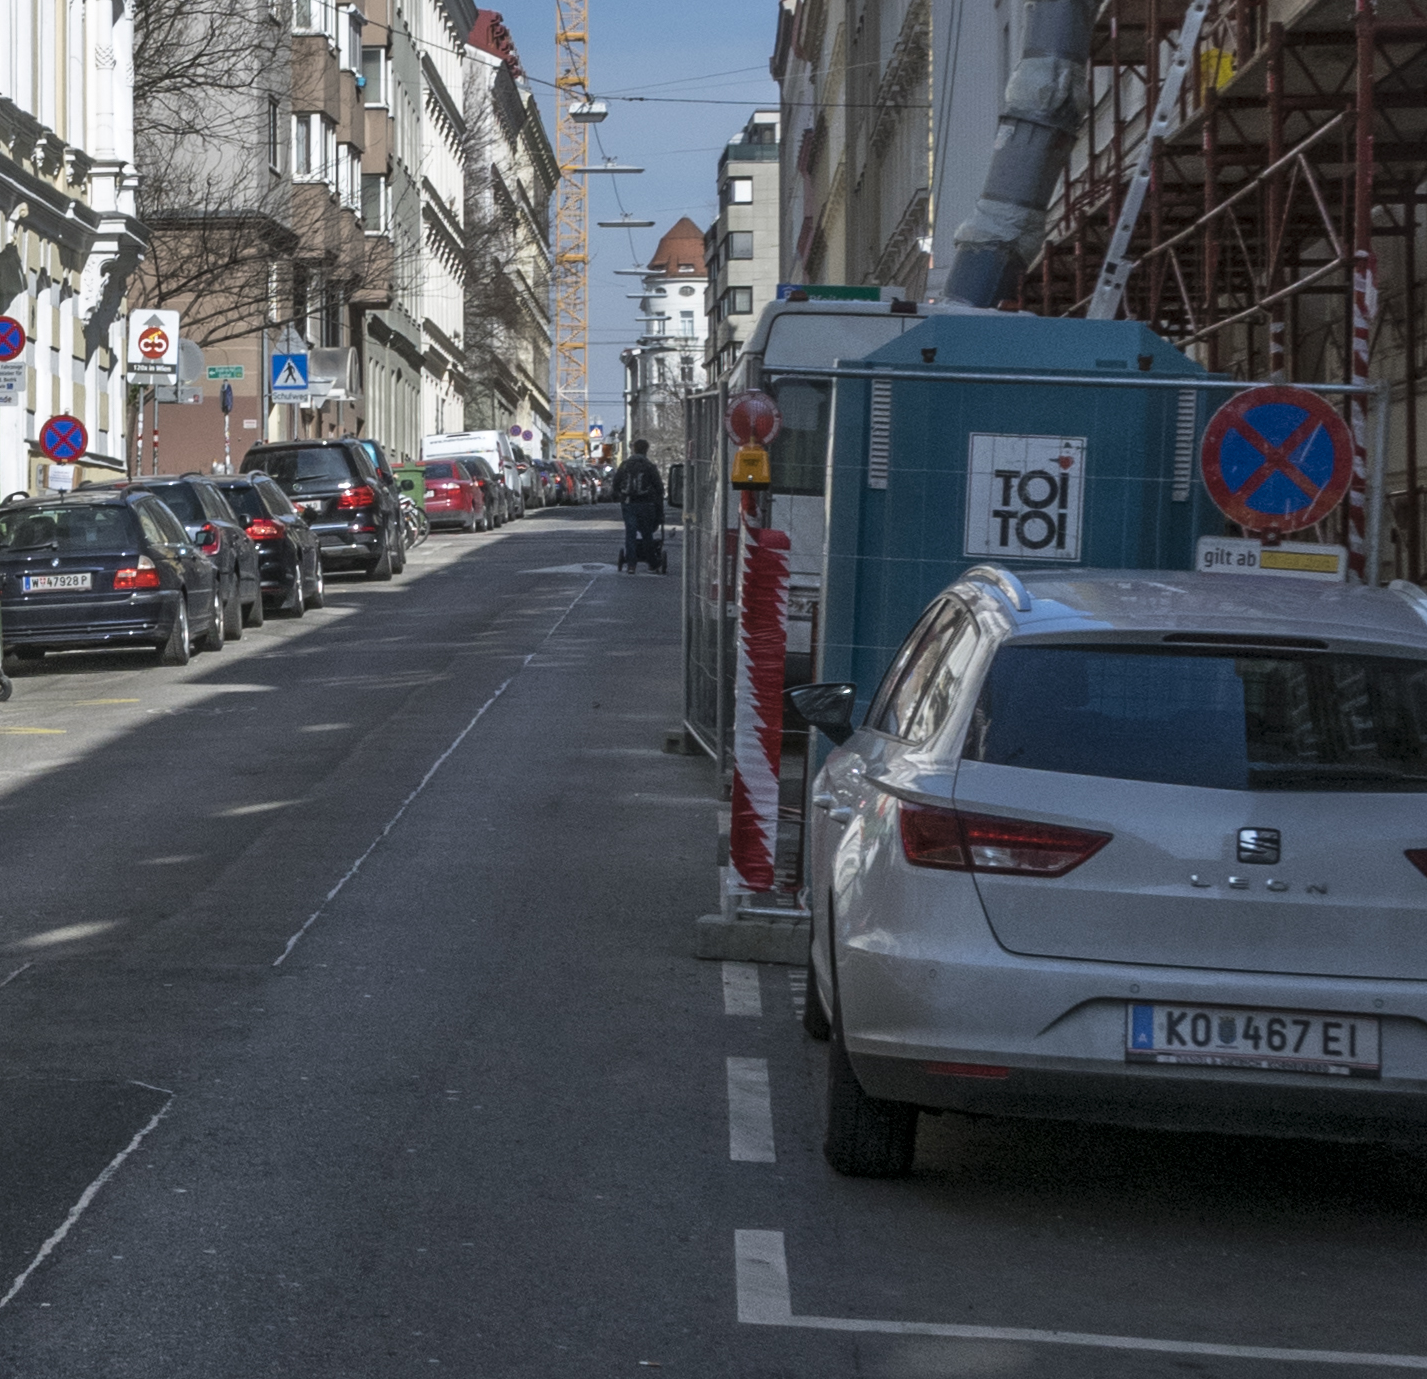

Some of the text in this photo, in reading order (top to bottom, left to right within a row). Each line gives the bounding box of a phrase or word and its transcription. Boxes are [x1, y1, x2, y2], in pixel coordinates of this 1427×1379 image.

[273, 392, 308, 401] Schulweg
[992, 509, 1067, 550] TOI
[1204, 548, 1232, 568] gilt
[1237, 551, 1256, 567] ab
[32, 575, 87, 588] W 47928 P
[1191, 875, 1327, 894] LEON
[1166, 1010, 1211, 1047] KO
[1242, 1015, 1311, 1054] 467
